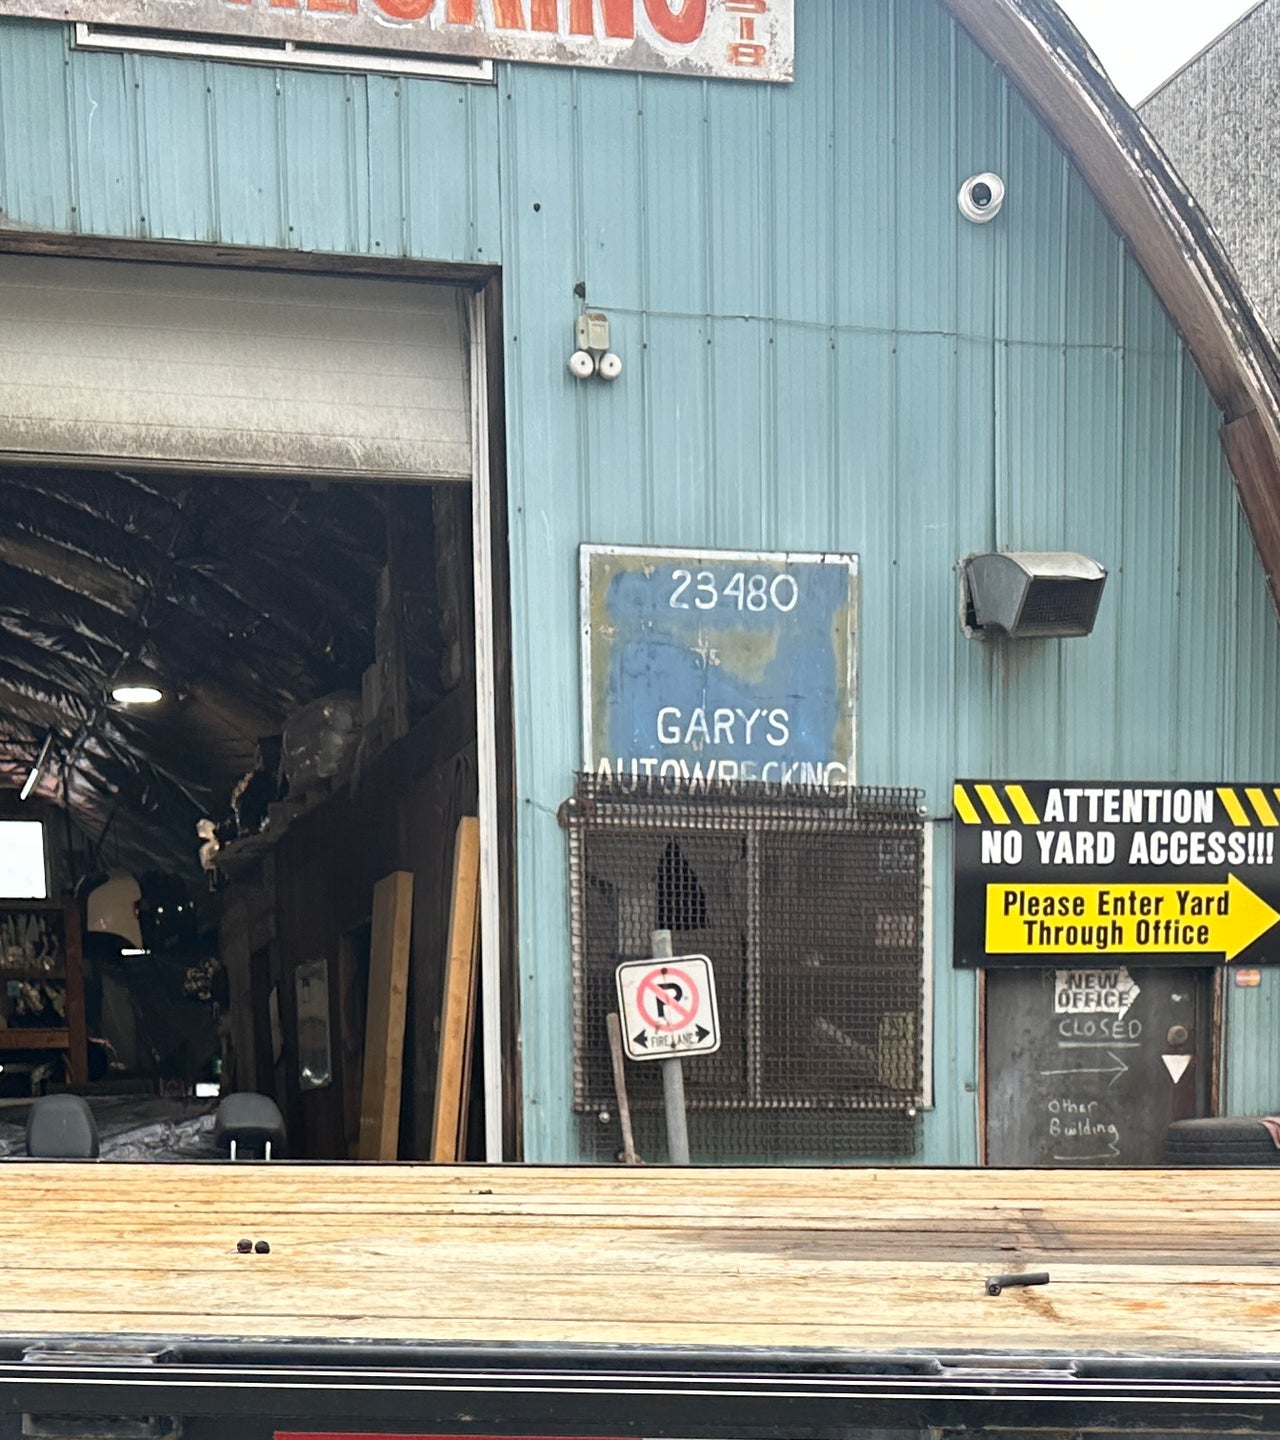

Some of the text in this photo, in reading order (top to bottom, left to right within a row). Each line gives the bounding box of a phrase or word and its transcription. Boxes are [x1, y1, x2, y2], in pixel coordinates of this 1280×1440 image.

[669, 569, 799, 612] 23480
[656, 706, 791, 747] GARY'S
[1043, 788, 1215, 824] ATTENTION
[981, 830, 1275, 866] NO YARD ACCESS!!!
[1003, 890, 1230, 917] Please Enter Yard
[1023, 919, 1209, 950] Through Office
[1065, 972, 1119, 989] NEW
[1058, 989, 1130, 1008] OFFICE
[651, 1034, 670, 1048] FIRE
[1059, 1018, 1142, 1039] CLOSED
[1048, 1099, 1098, 1115] Other
[1049, 1117, 1119, 1145] Building
